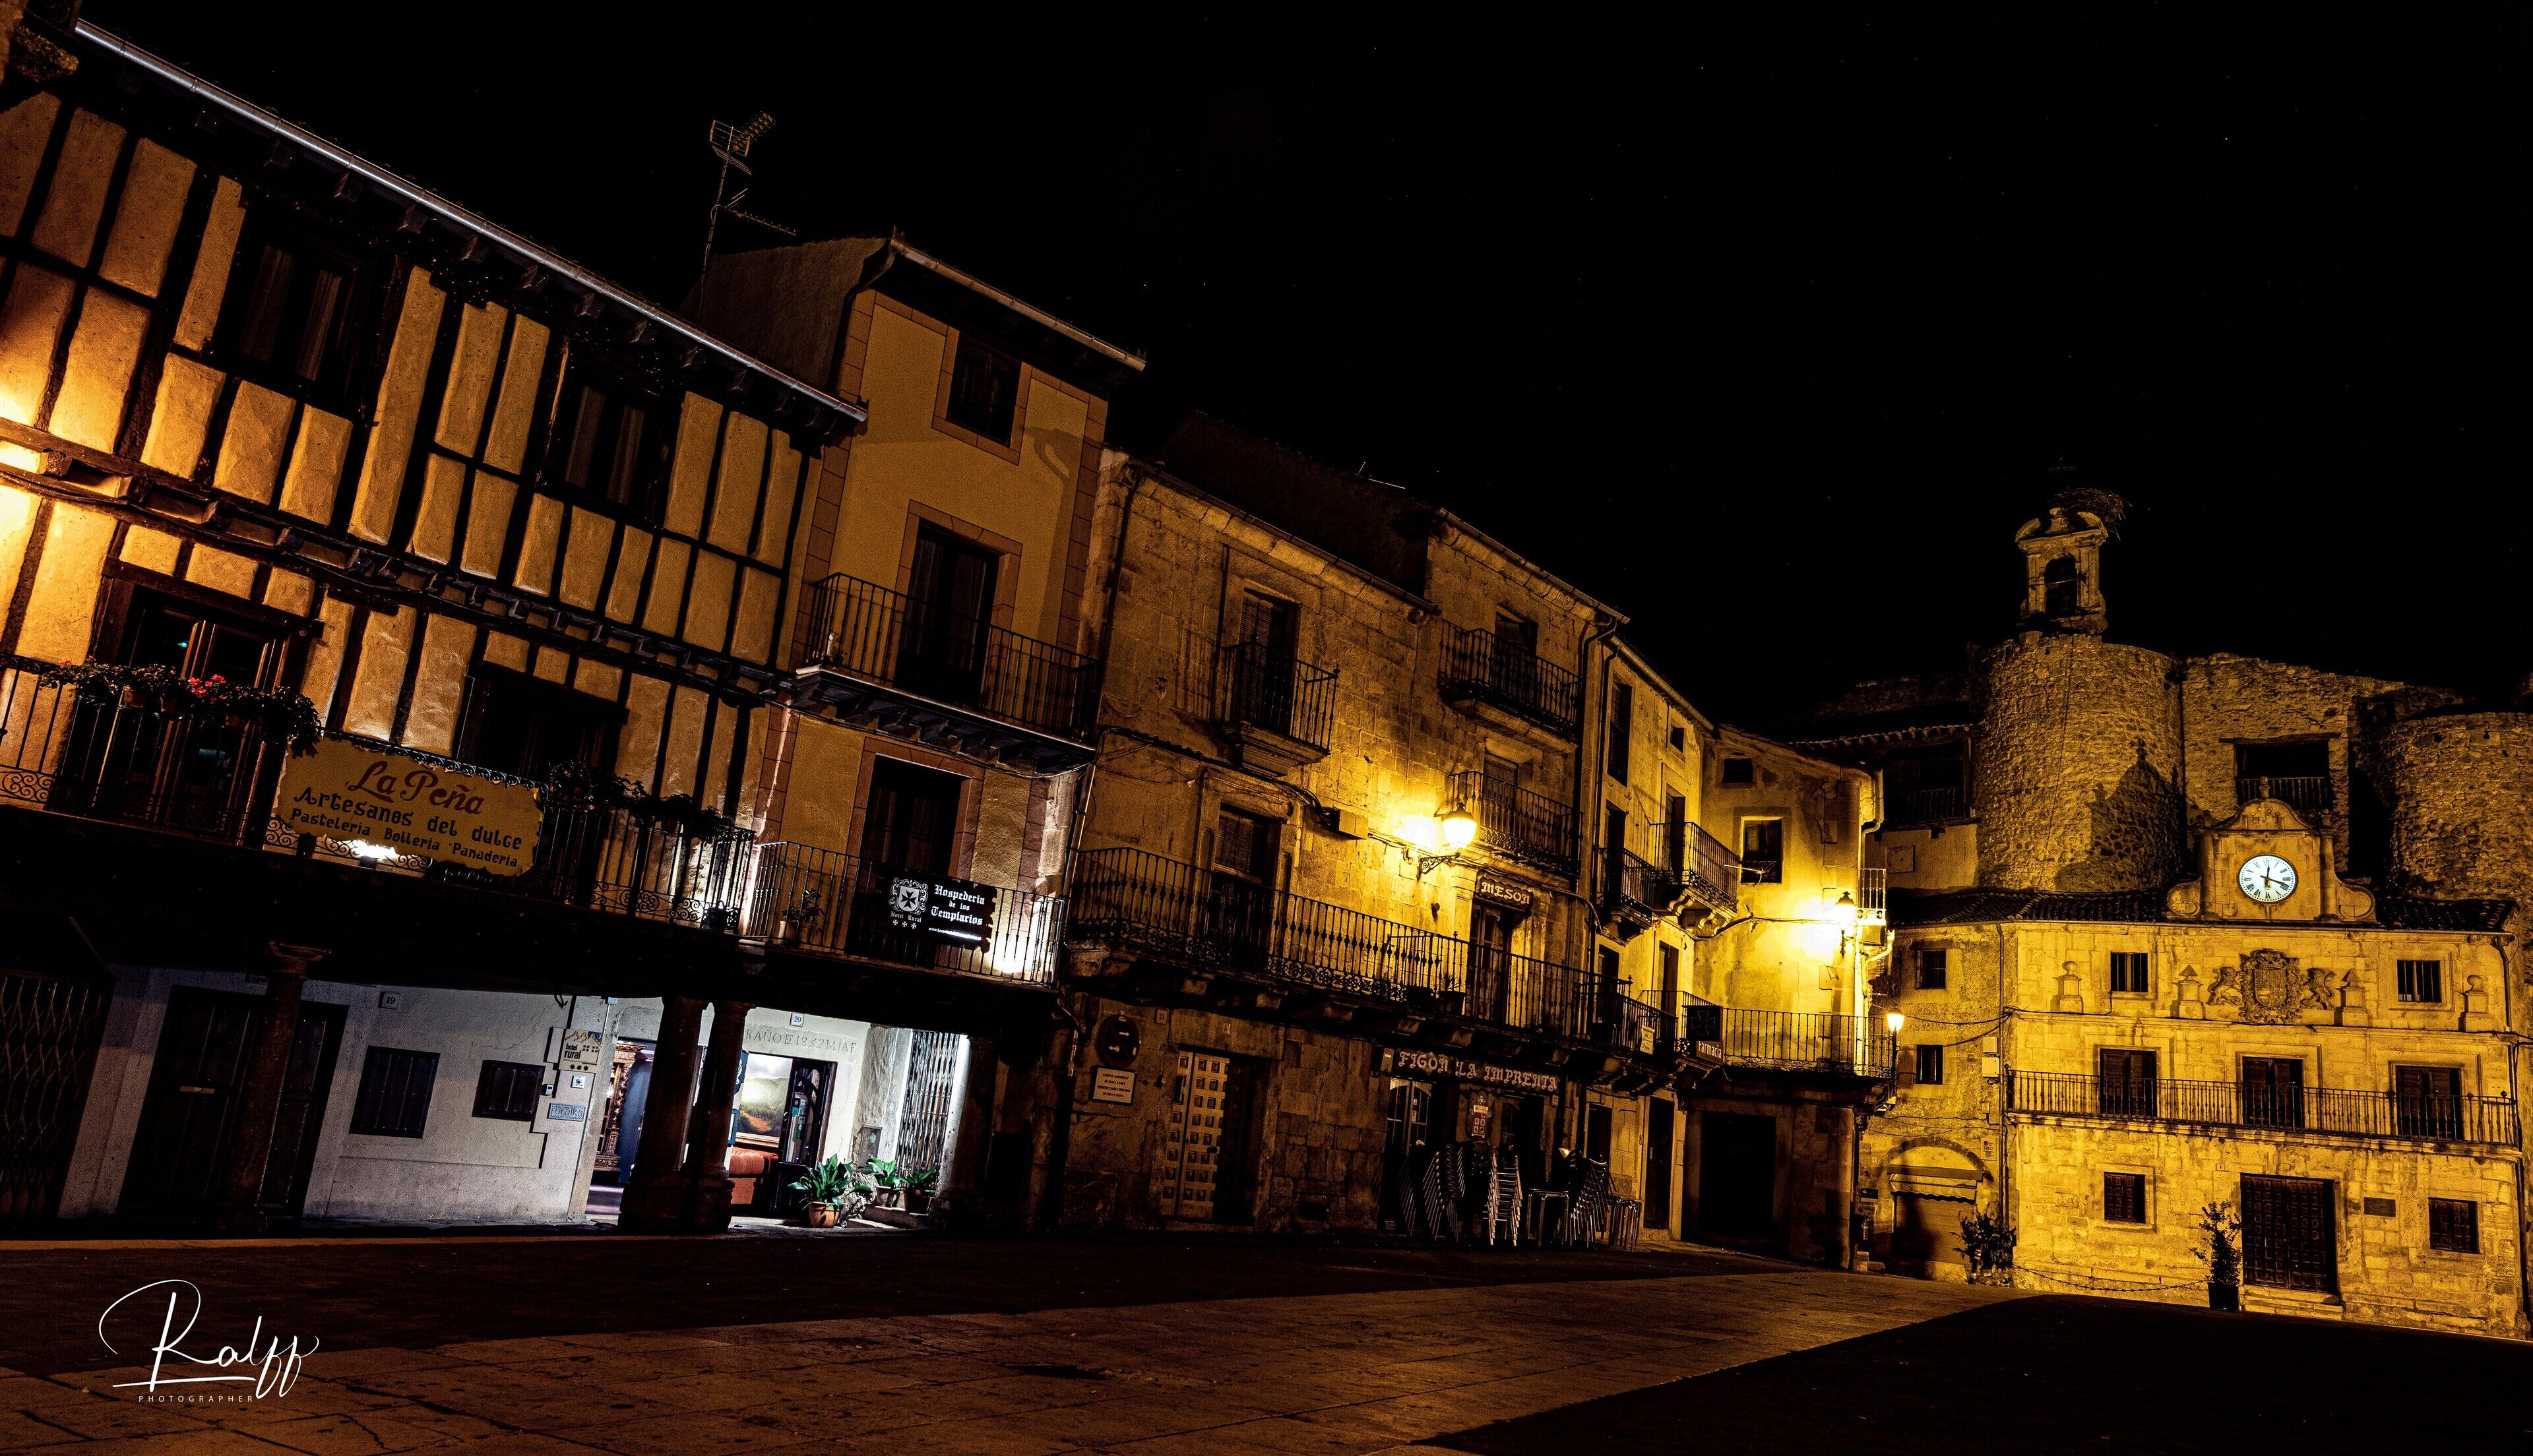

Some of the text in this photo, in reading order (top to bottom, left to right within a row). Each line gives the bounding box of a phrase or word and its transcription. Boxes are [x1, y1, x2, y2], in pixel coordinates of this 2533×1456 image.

[346, 760, 484, 815] La Peña
[290, 808, 371, 835] Pasteleria
[385, 828, 439, 851] Bolleria
[294, 787, 522, 850] Artesanos del dulce
[934, 884, 985, 905] Hospederia
[1481, 882, 1530, 904] MESON
[931, 906, 983, 925] Templarios
[563, 1050, 581, 1060] rural
[1698, 1041, 1722, 1058] Farmacia
[1398, 1051, 1559, 1091] FIGON LA IMPRENTA
